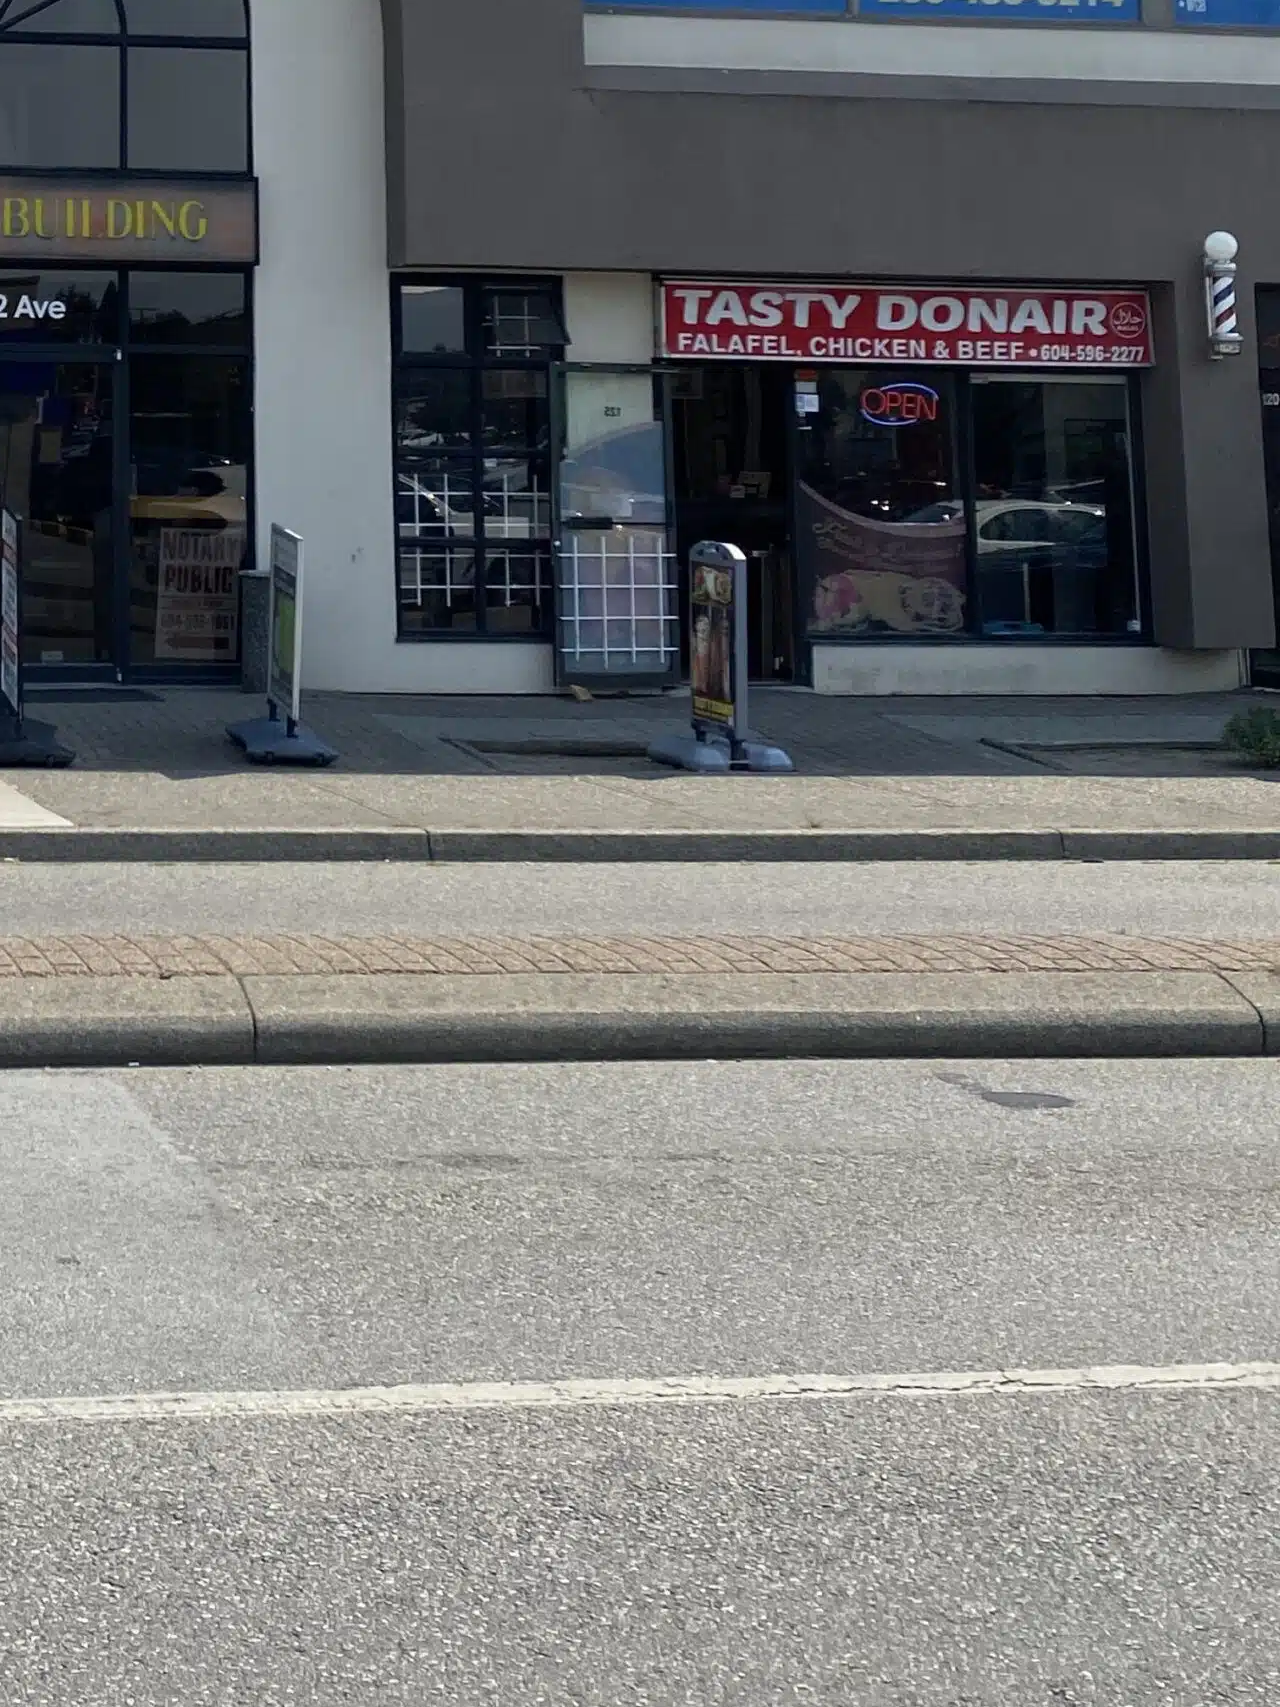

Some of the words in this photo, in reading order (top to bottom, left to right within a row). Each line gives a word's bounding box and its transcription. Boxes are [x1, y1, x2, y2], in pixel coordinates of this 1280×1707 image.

[3, 197, 208, 242] BUILDING
[13, 295, 67, 320] Ave
[672, 288, 862, 330] TASTY
[876, 294, 1108, 336] DONAIR
[677, 332, 803, 357] FALAFEL,
[809, 335, 926, 359] CHICKEN
[931, 340, 950, 359] &
[957, 340, 1025, 361] BEEF
[1040, 344, 1145, 362] 604-596-2277
[862, 388, 937, 420] OPEN
[163, 531, 238, 562] NOTARY
[164, 564, 233, 594] PUBLIC
